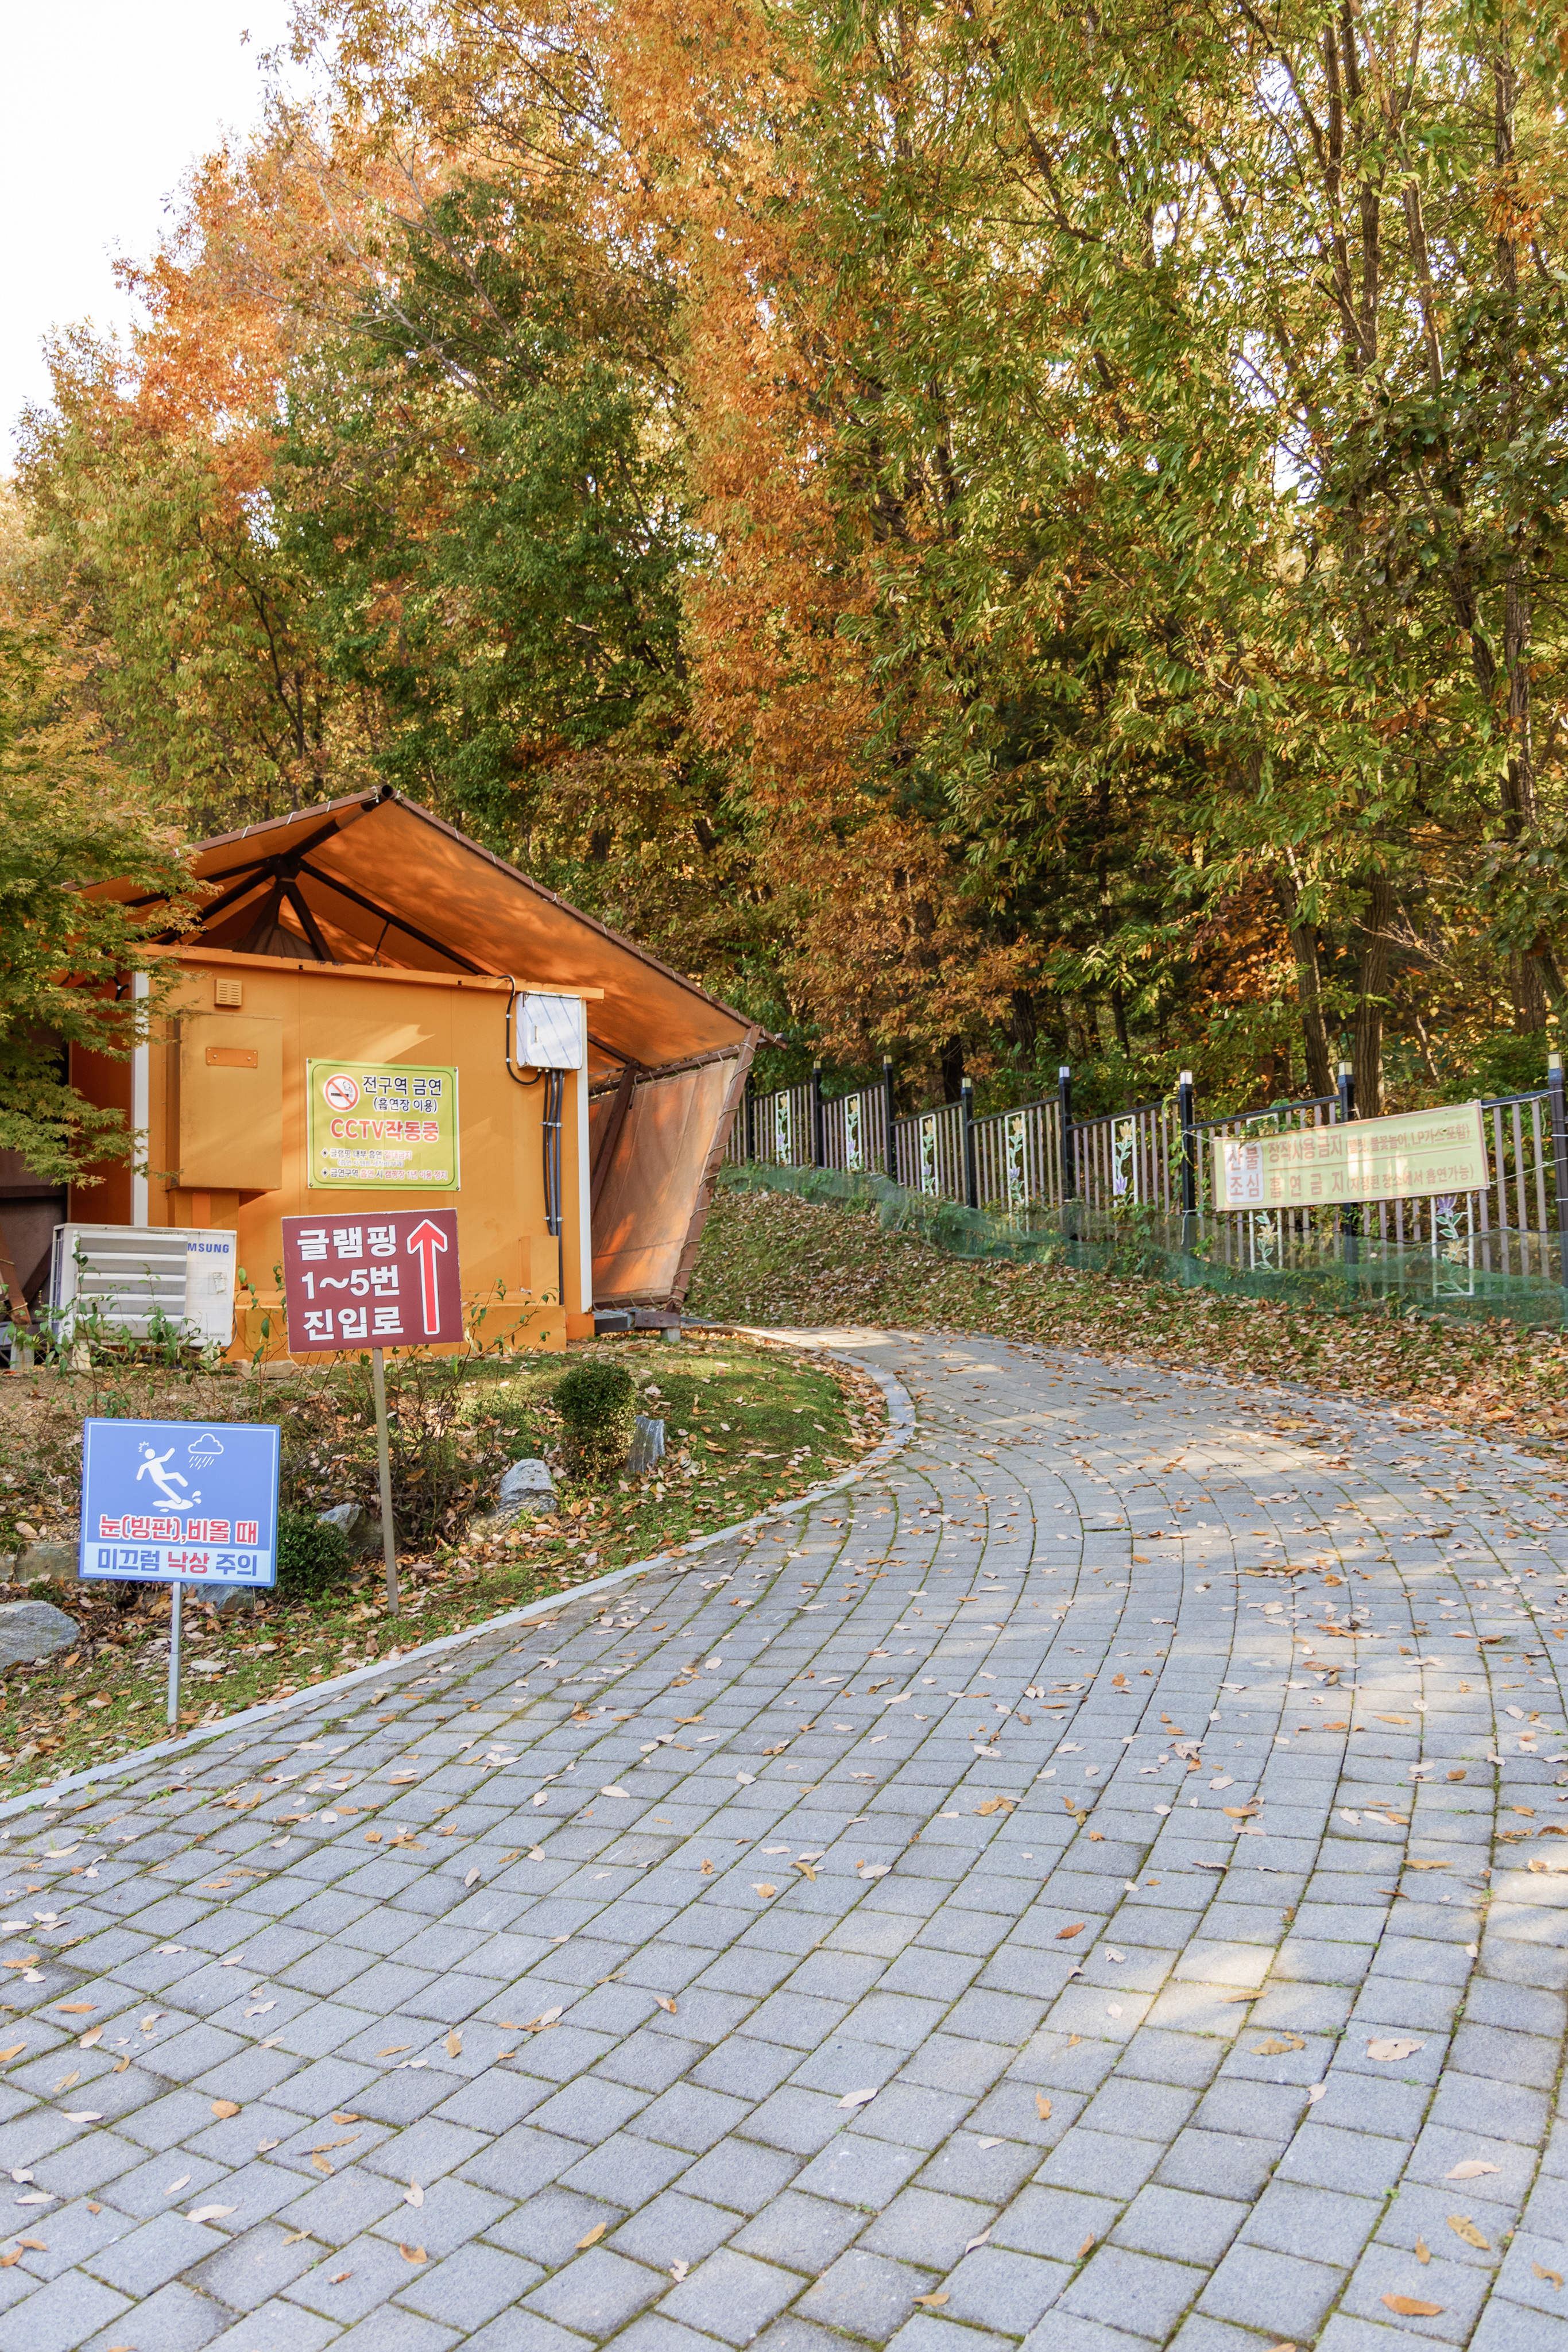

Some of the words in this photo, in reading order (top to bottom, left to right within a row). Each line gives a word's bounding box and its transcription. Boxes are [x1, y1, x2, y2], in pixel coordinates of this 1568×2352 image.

[363, 1076, 408, 1095] 전구역
[412, 1078, 442, 1096] 금연
[374, 1098, 409, 1112] (흡연장
[413, 1099, 437, 1113] 이용)
[331, 1119, 439, 1142] CCTV작동중
[330, 1149, 351, 1158] 글램핑
[353, 1150, 367, 1159] 내부
[369, 1150, 382, 1159] 흡연
[384, 1151, 412, 1160] 절대금지
[1229, 1147, 1260, 1171] 산불
[331, 1169, 358, 1178] 금연구역
[361, 1169, 374, 1178] 흡연
[376, 1169, 383, 1178] 시
[385, 1170, 405, 1179] 캠핑장
[406, 1170, 417, 1179] 1년
[419, 1171, 432, 1180] 이용
[433, 1171, 447, 1180] 정지
[1230, 1173, 1260, 1198] 조심
[1346, 1175, 1379, 1193] (지정된
[1383, 1169, 1423, 1189] 장소에서
[1426, 1163, 1474, 1185] 흡연가능)
[187, 1243, 229, 1253] MSUNG
[296, 1224, 397, 1261] 글램핑
[301, 1264, 400, 1299] 1~5번
[303, 1306, 404, 1341] 진입로
[235, 1519, 258, 1545] 때
[98, 1548, 160, 1572] 미끄럼
[168, 1551, 210, 1574] 낙상
[216, 1553, 257, 1576] 주의
